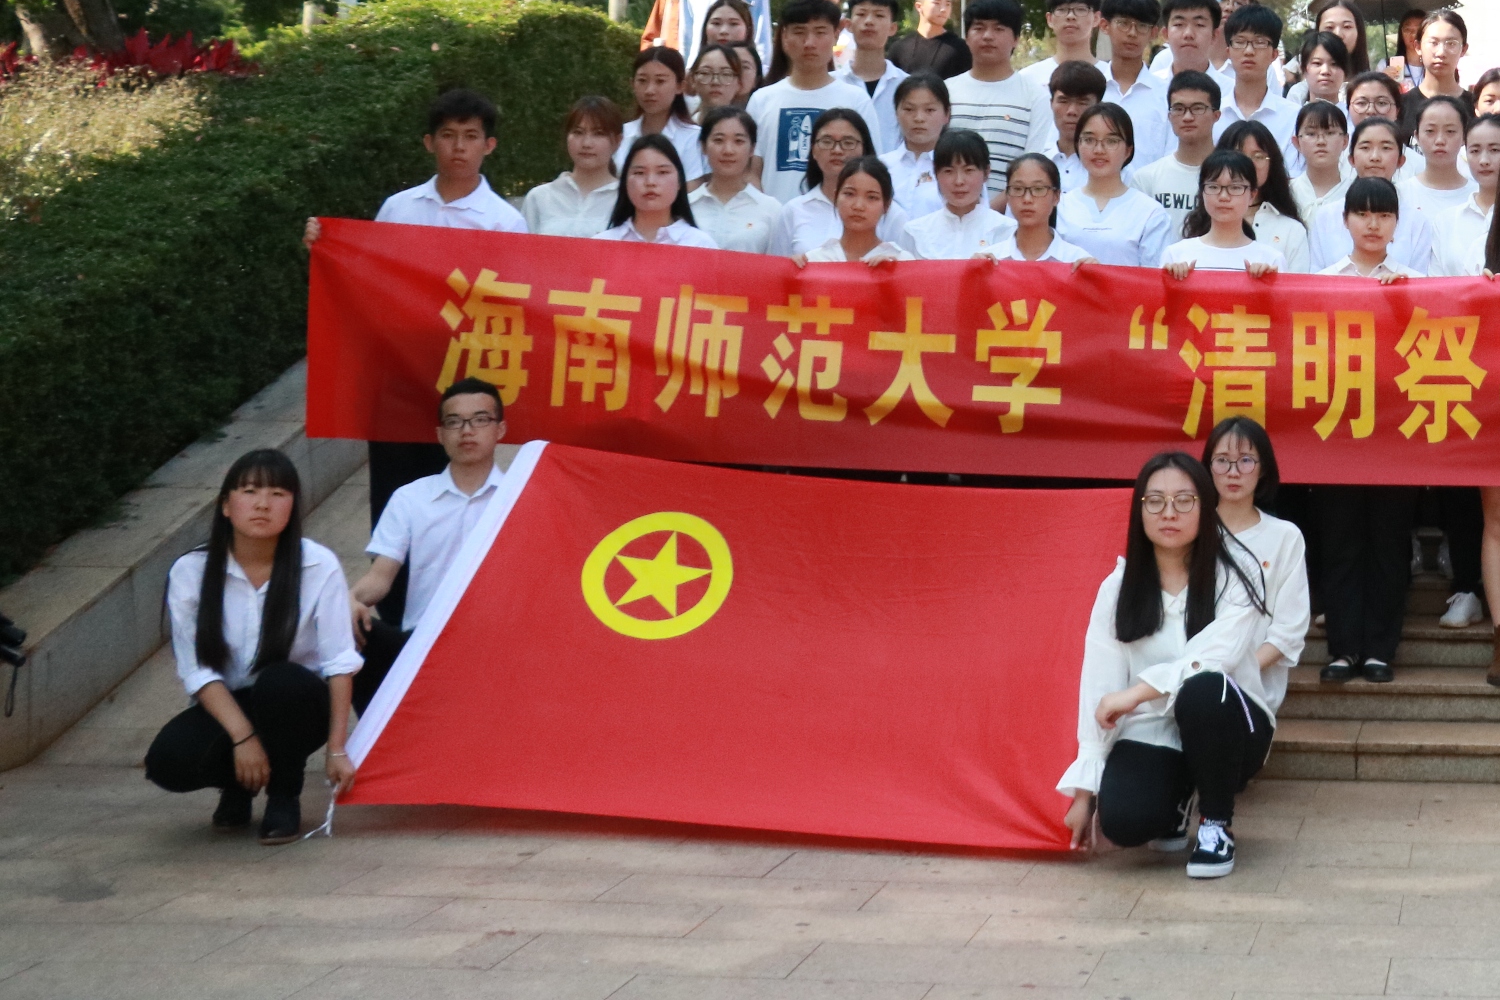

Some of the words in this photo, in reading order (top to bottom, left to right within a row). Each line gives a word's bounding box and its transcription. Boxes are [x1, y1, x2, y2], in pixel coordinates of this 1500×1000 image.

[436, 268, 1063, 434] 海南师范大学
